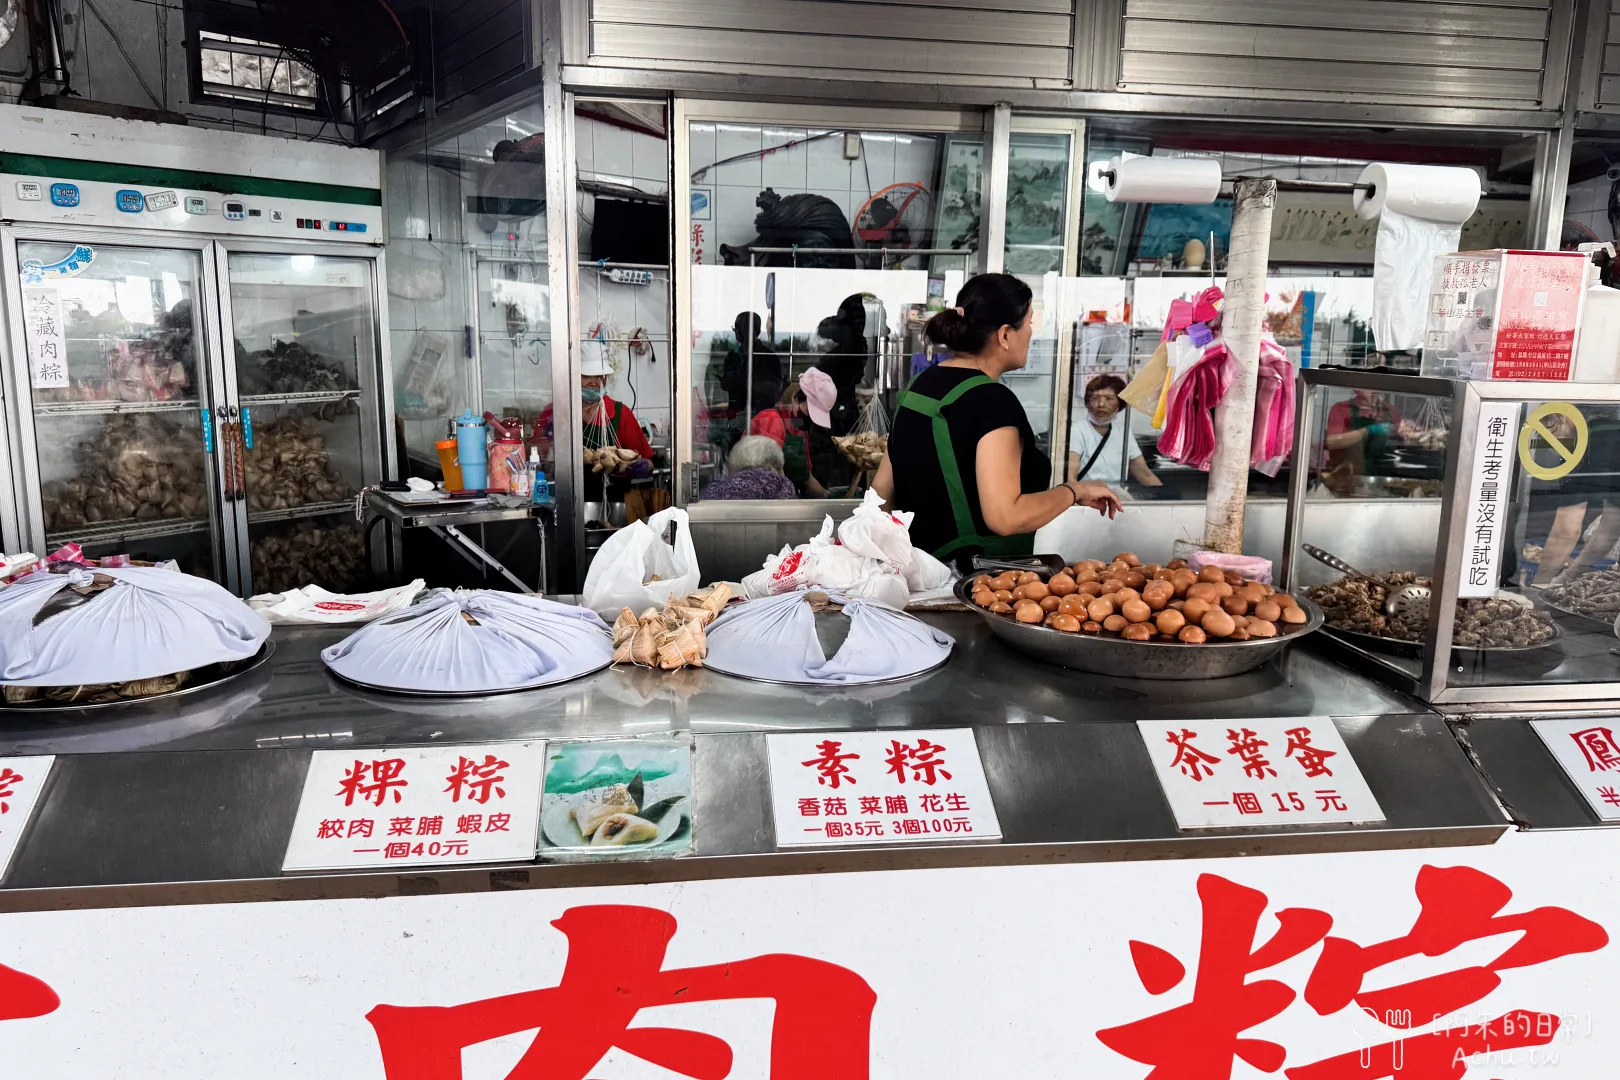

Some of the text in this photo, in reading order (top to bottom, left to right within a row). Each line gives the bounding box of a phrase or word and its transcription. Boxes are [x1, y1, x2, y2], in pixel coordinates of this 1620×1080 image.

[1437, 307, 1484, 319] 華山基金會
[33, 294, 62, 381] 冷藏肉粽
[1469, 416, 1508, 586] 衛生考量沒有試吃
[802, 739, 952, 789] 素粽
[1167, 728, 1336, 782] 茶葉蛋
[337, 755, 509, 807] 粿粽
[798, 793, 970, 817] 香菇 菜脯 花生
[317, 813, 511, 839] 絞肉 菜脯 蝦皮
[804, 817, 973, 838] 一個35元 3個100元
[353, 839, 469, 859] 一個40元
